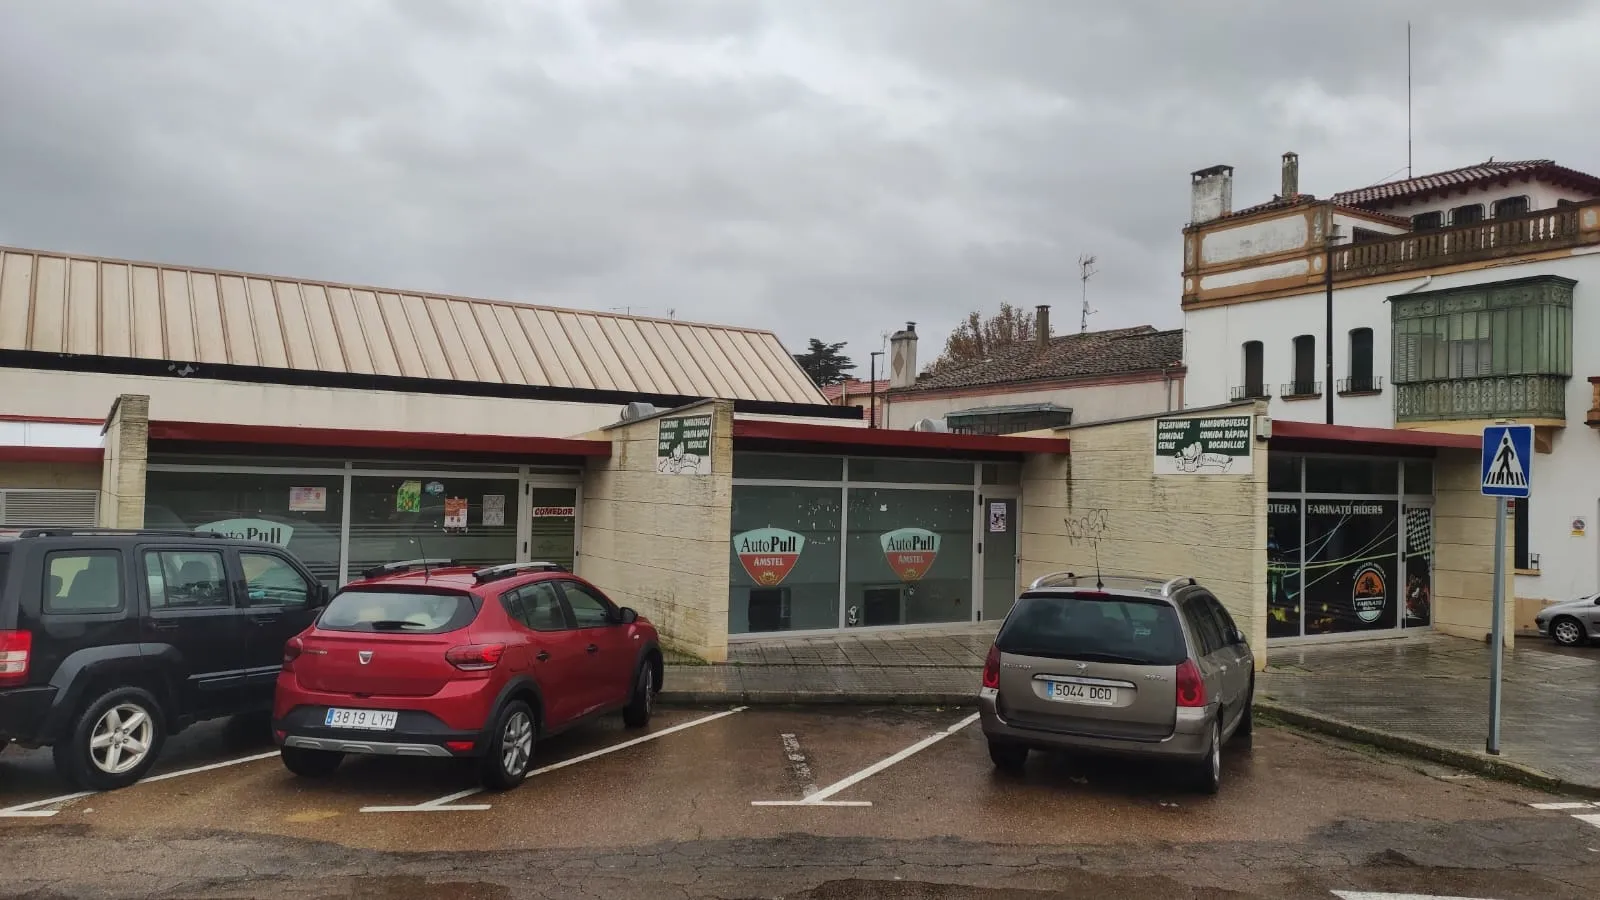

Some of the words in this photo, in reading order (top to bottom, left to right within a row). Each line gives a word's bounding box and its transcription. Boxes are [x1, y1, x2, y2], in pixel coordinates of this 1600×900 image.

[1158, 420, 1191, 430] DESAYUNOS
[1199, 418, 1249, 428] HAMBURGUESAS
[1158, 431, 1185, 441] COMIDAS
[1199, 430, 1223, 439] COMIDA
[1224, 428, 1248, 439] RÁPIDA
[1158, 441, 1176, 450] CENAS
[1208, 440, 1246, 449] BOCADILLOS
[535, 507, 574, 516] COMEDOR
[1307, 504, 1352, 515] FARINATO
[1353, 504, 1384, 515] RIDERS
[740, 536, 796, 553] AutoPull
[886, 535, 935, 551] AutoPull
[753, 556, 785, 567] AMSTEL
[897, 554, 925, 565] AMSTEL
[1055, 684, 1084, 698] 5044
[1089, 687, 1112, 701] DCD
[333, 711, 366, 725] 3819
[371, 714, 395, 727] LYH
